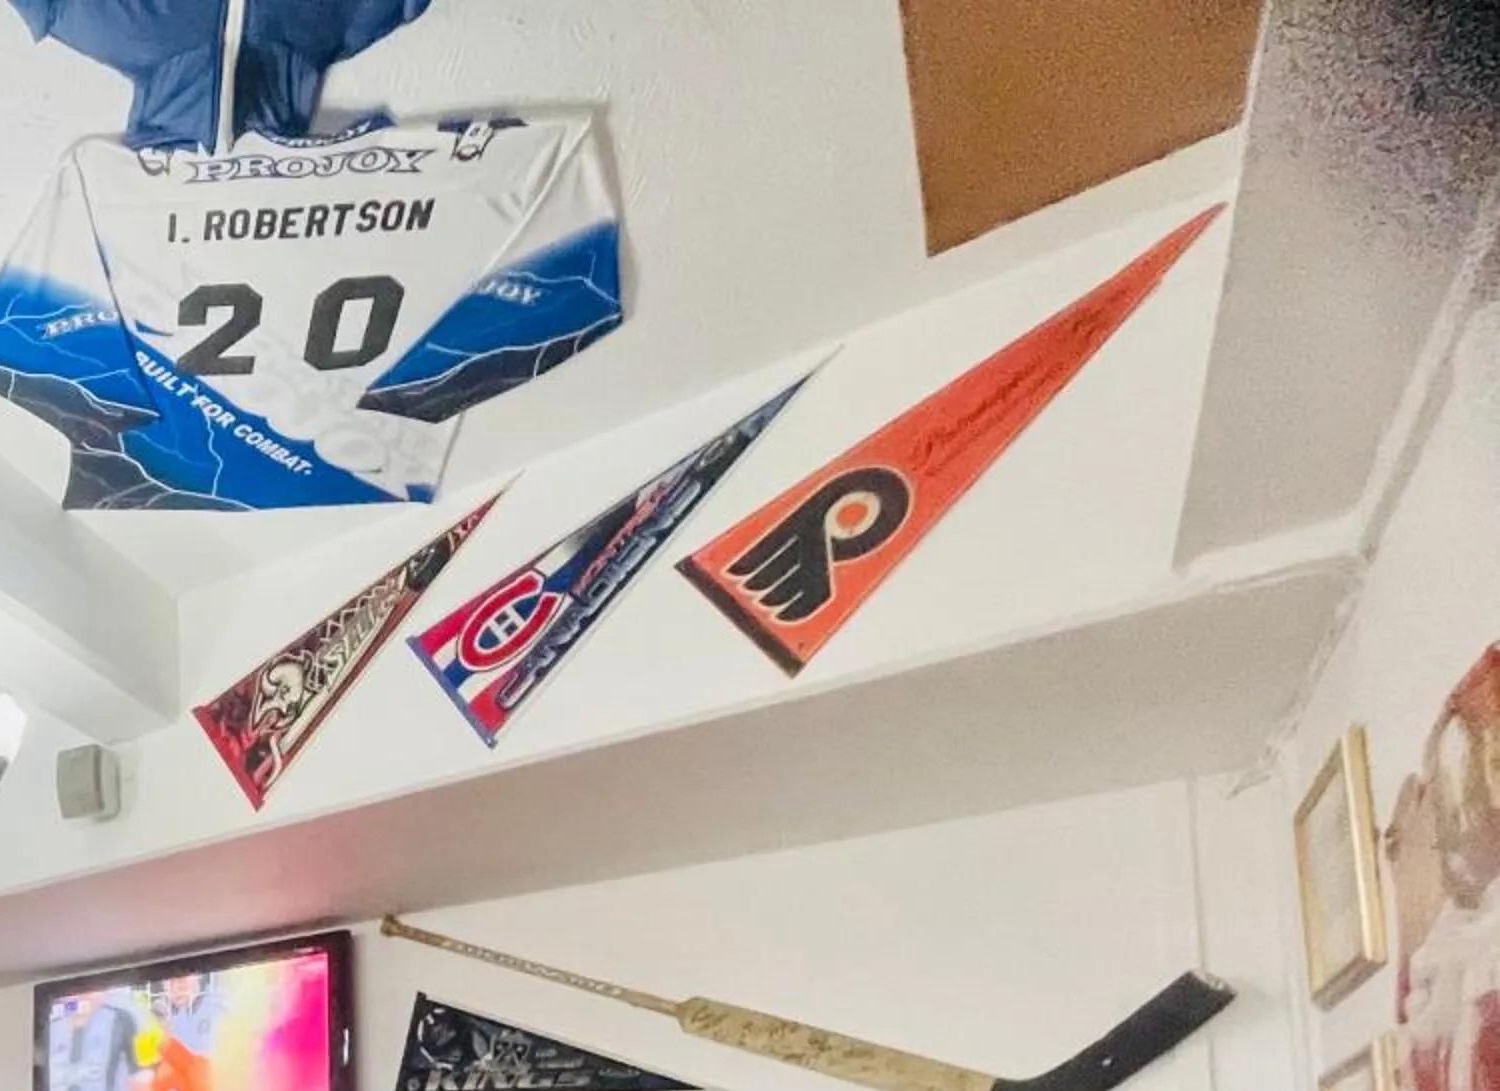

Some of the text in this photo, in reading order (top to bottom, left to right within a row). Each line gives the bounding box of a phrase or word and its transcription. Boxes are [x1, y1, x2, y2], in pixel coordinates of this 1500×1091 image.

[184, 146, 437, 184] PROJOY
[203, 198, 437, 242] ROBERTSON
[176, 274, 406, 376] 20
[191, 394, 237, 429] FOR
